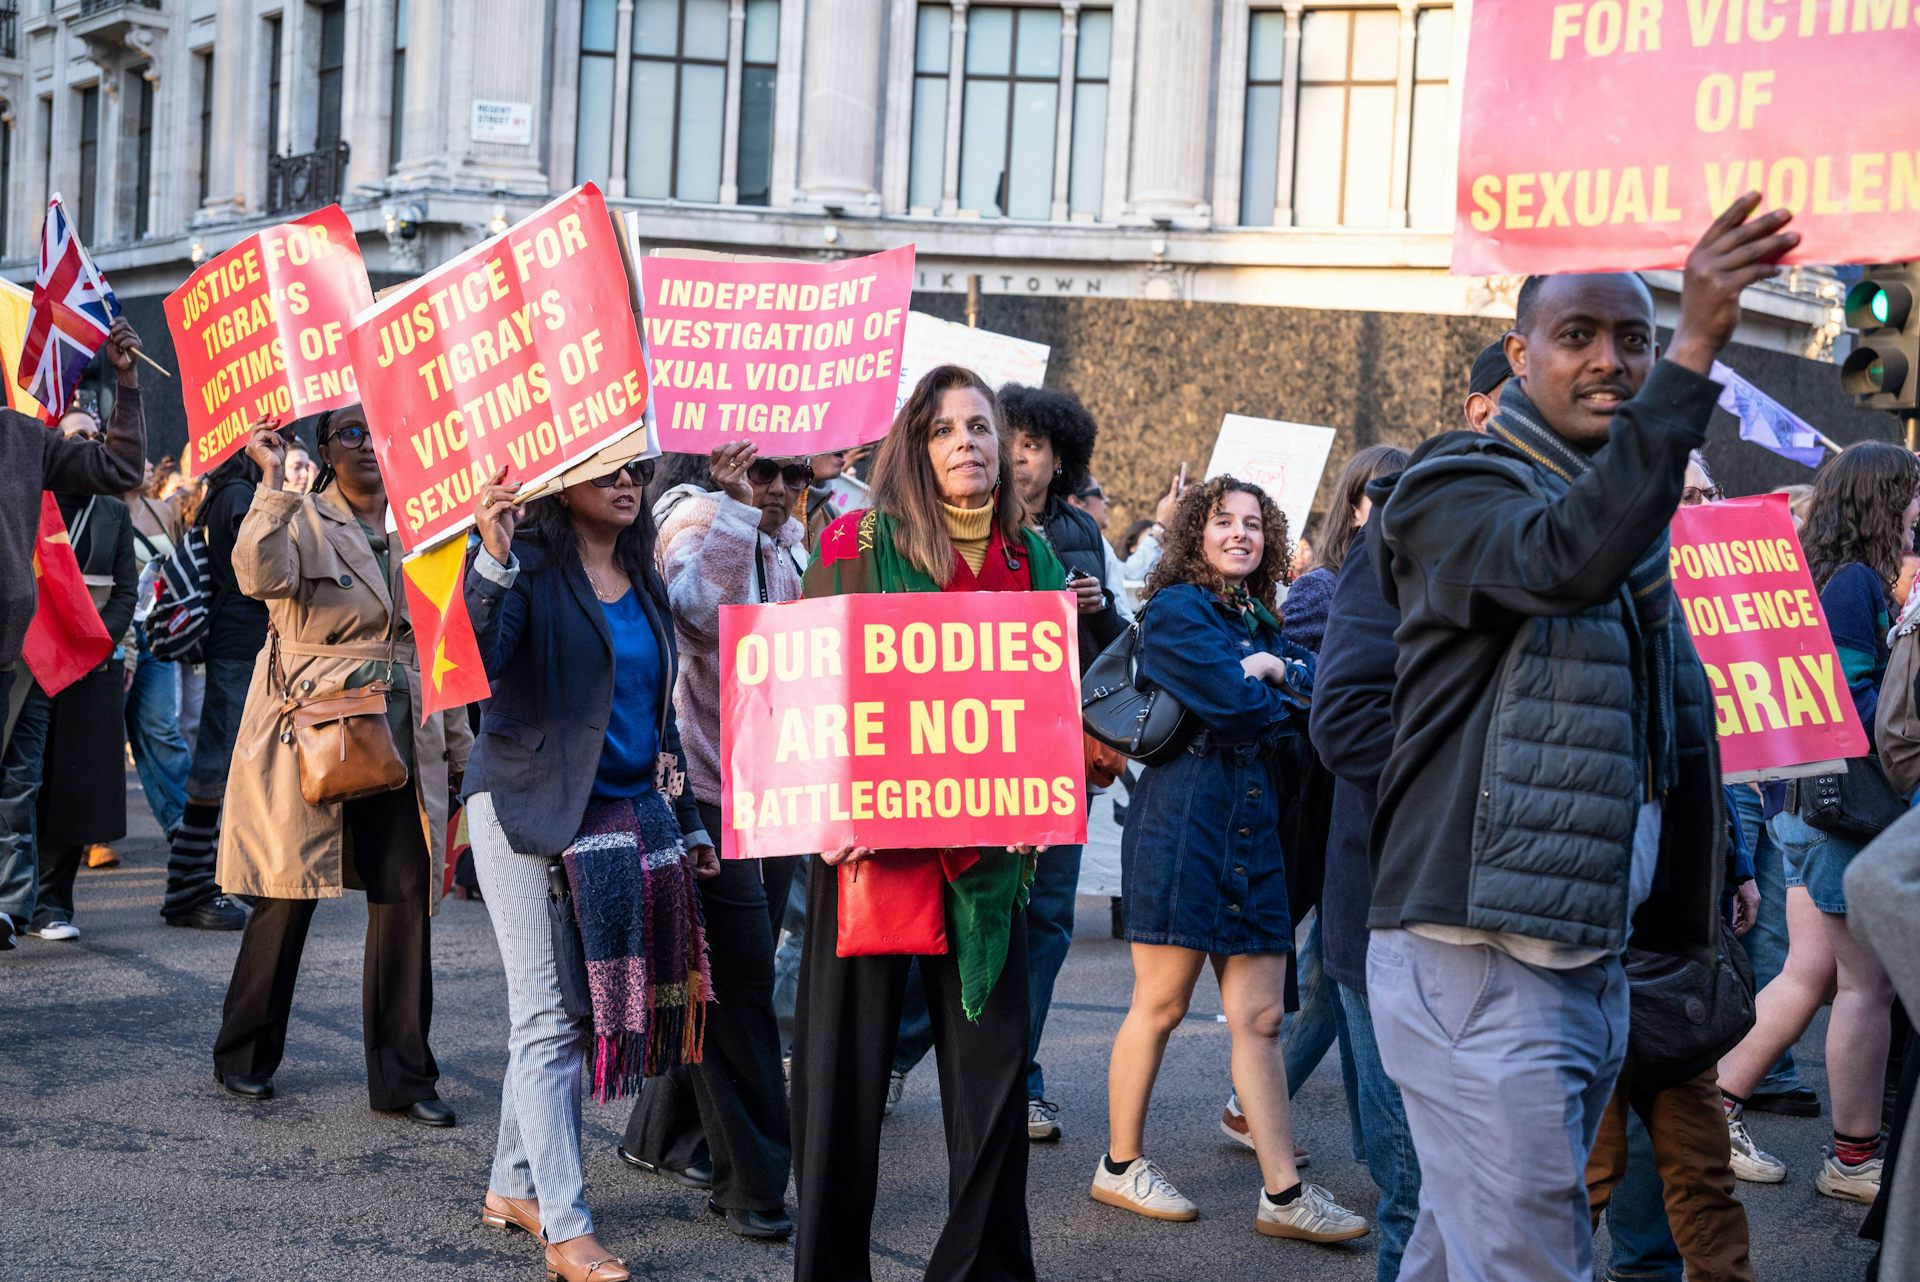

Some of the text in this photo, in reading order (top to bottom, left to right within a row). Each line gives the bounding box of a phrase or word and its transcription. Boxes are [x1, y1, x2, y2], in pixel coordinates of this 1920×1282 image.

[1548, 0, 1920, 60] FOR VICTIM
[1694, 70, 1775, 133] OF
[1470, 165, 1681, 232] SEXUAL
[182, 224, 334, 331] JUSTICE FOR
[377, 213, 588, 368] JUSTICE FOR
[658, 275, 877, 312] INDEPENDENT
[202, 282, 310, 361] TIGRAY'S
[418, 289, 566, 402] TIGRAY'S
[643, 308, 902, 351] VESTIGATION OF
[201, 320, 344, 416] VICTIMS OF
[410, 329, 604, 470] VICTIMS OF
[650, 359, 733, 390] XUAL
[745, 349, 894, 392] VIOLENCE
[198, 406, 254, 463] SEXUAL
[506, 369, 642, 471] VIOLENCE
[671, 401, 831, 433] IN TIGRAY
[1681, 589, 1819, 636] IOLENCE
[736, 621, 1063, 685] OUR BODIES
[1703, 654, 1844, 737] GRAY
[775, 698, 1025, 763] ARE NOT
[733, 776, 1076, 830] BATTLEGROUNDS
